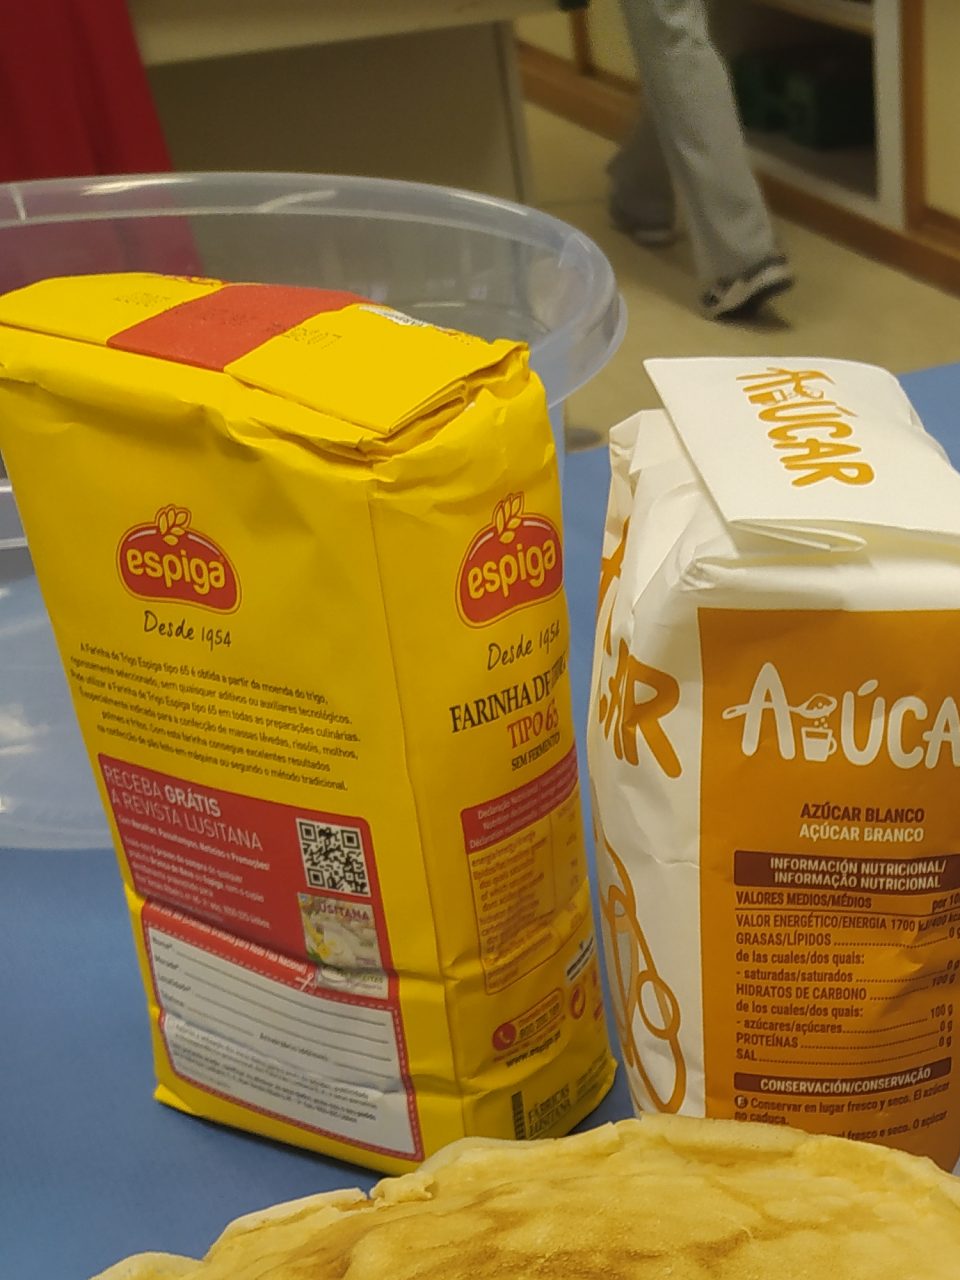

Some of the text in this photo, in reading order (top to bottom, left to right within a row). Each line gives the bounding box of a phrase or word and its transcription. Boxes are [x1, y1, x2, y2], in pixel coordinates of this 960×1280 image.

[126, 549, 226, 595] espiga
[467, 539, 556, 600] espiga
[144, 610, 231, 651] Desde 1954
[487, 633, 532, 671] Desde
[228, 674, 248, 689] partir
[250, 680, 260, 689] da
[261, 681, 293, 696] moenda
[294, 688, 304, 698] do
[449, 681, 532, 733] FARINHA
[532, 671, 551, 702] DE
[232, 709, 252, 722] todas
[265, 714, 314, 737] preparações
[507, 698, 559, 749] TIPO 65
[287, 754, 329, 773] resultados
[511, 732, 560, 771] SEM FERMENTO
[103, 765, 221, 817] RECEBA GRÁTIS
[270, 768, 300, 782] método
[301, 771, 347, 792] tradicional.
[122, 792, 182, 827] REVISTA
[184, 813, 263, 850] LUSITANA
[801, 802, 924, 823] AZÚCAR BLANCO
[800, 824, 924, 842] AÇÚCAR BRANCO
[770, 858, 947, 877] INFORMACIÓN NUTRICIONAL/
[774, 872, 941, 891] INFORMAÇÃO NUTRICIONAL
[736, 891, 784, 905] VALORES
[787, 893, 872, 909] MEDIOS/MÉDIOS
[736, 914, 770, 928] VALOR
[774, 912, 886, 929] ENERGÉTICO/ENERGIA
[891, 919, 915, 932] 1700
[736, 931, 831, 946] GRASAS/LÍPIDOS
[949, 927, 954, 938] 0
[736, 949, 865, 967] de las cuales/dos quais:
[744, 968, 853, 982] saturadas/saturados
[736, 983, 792, 998] HIDRATOS
[795, 987, 809, 999] DE
[812, 987, 867, 1000] CARBONO
[736, 1000, 863, 1020] de los cuales/dos quais:
[744, 1018, 842, 1035] azúcares/açúcares
[931, 1003, 946, 1018] 100
[736, 1032, 798, 1048] PROTEÍNAS
[940, 1020, 945, 1032] 0
[736, 1048, 757, 1061] SAL
[939, 1036, 944, 1047] 0
[760, 1067, 931, 1094] CONSERVACIÓN/CONSERVAÇÃO
[751, 1098, 802, 1112] Conservar
[805, 1104, 816, 1113] en
[819, 1102, 844, 1116] lugar
[847, 1101, 877, 1112] fresco
[879, 1100, 886, 1111] y
[888, 1096, 911, 1107] seco.
[913, 1089, 922, 1100] El
[923, 1082, 949, 1098] azúcar
[750, 1112, 789, 1125] caduca.
[847, 1130, 877, 1140] fresco
[888, 1124, 911, 1136] seco.
[912, 1118, 920, 1129] O
[921, 1110, 948, 1127] açúcar
